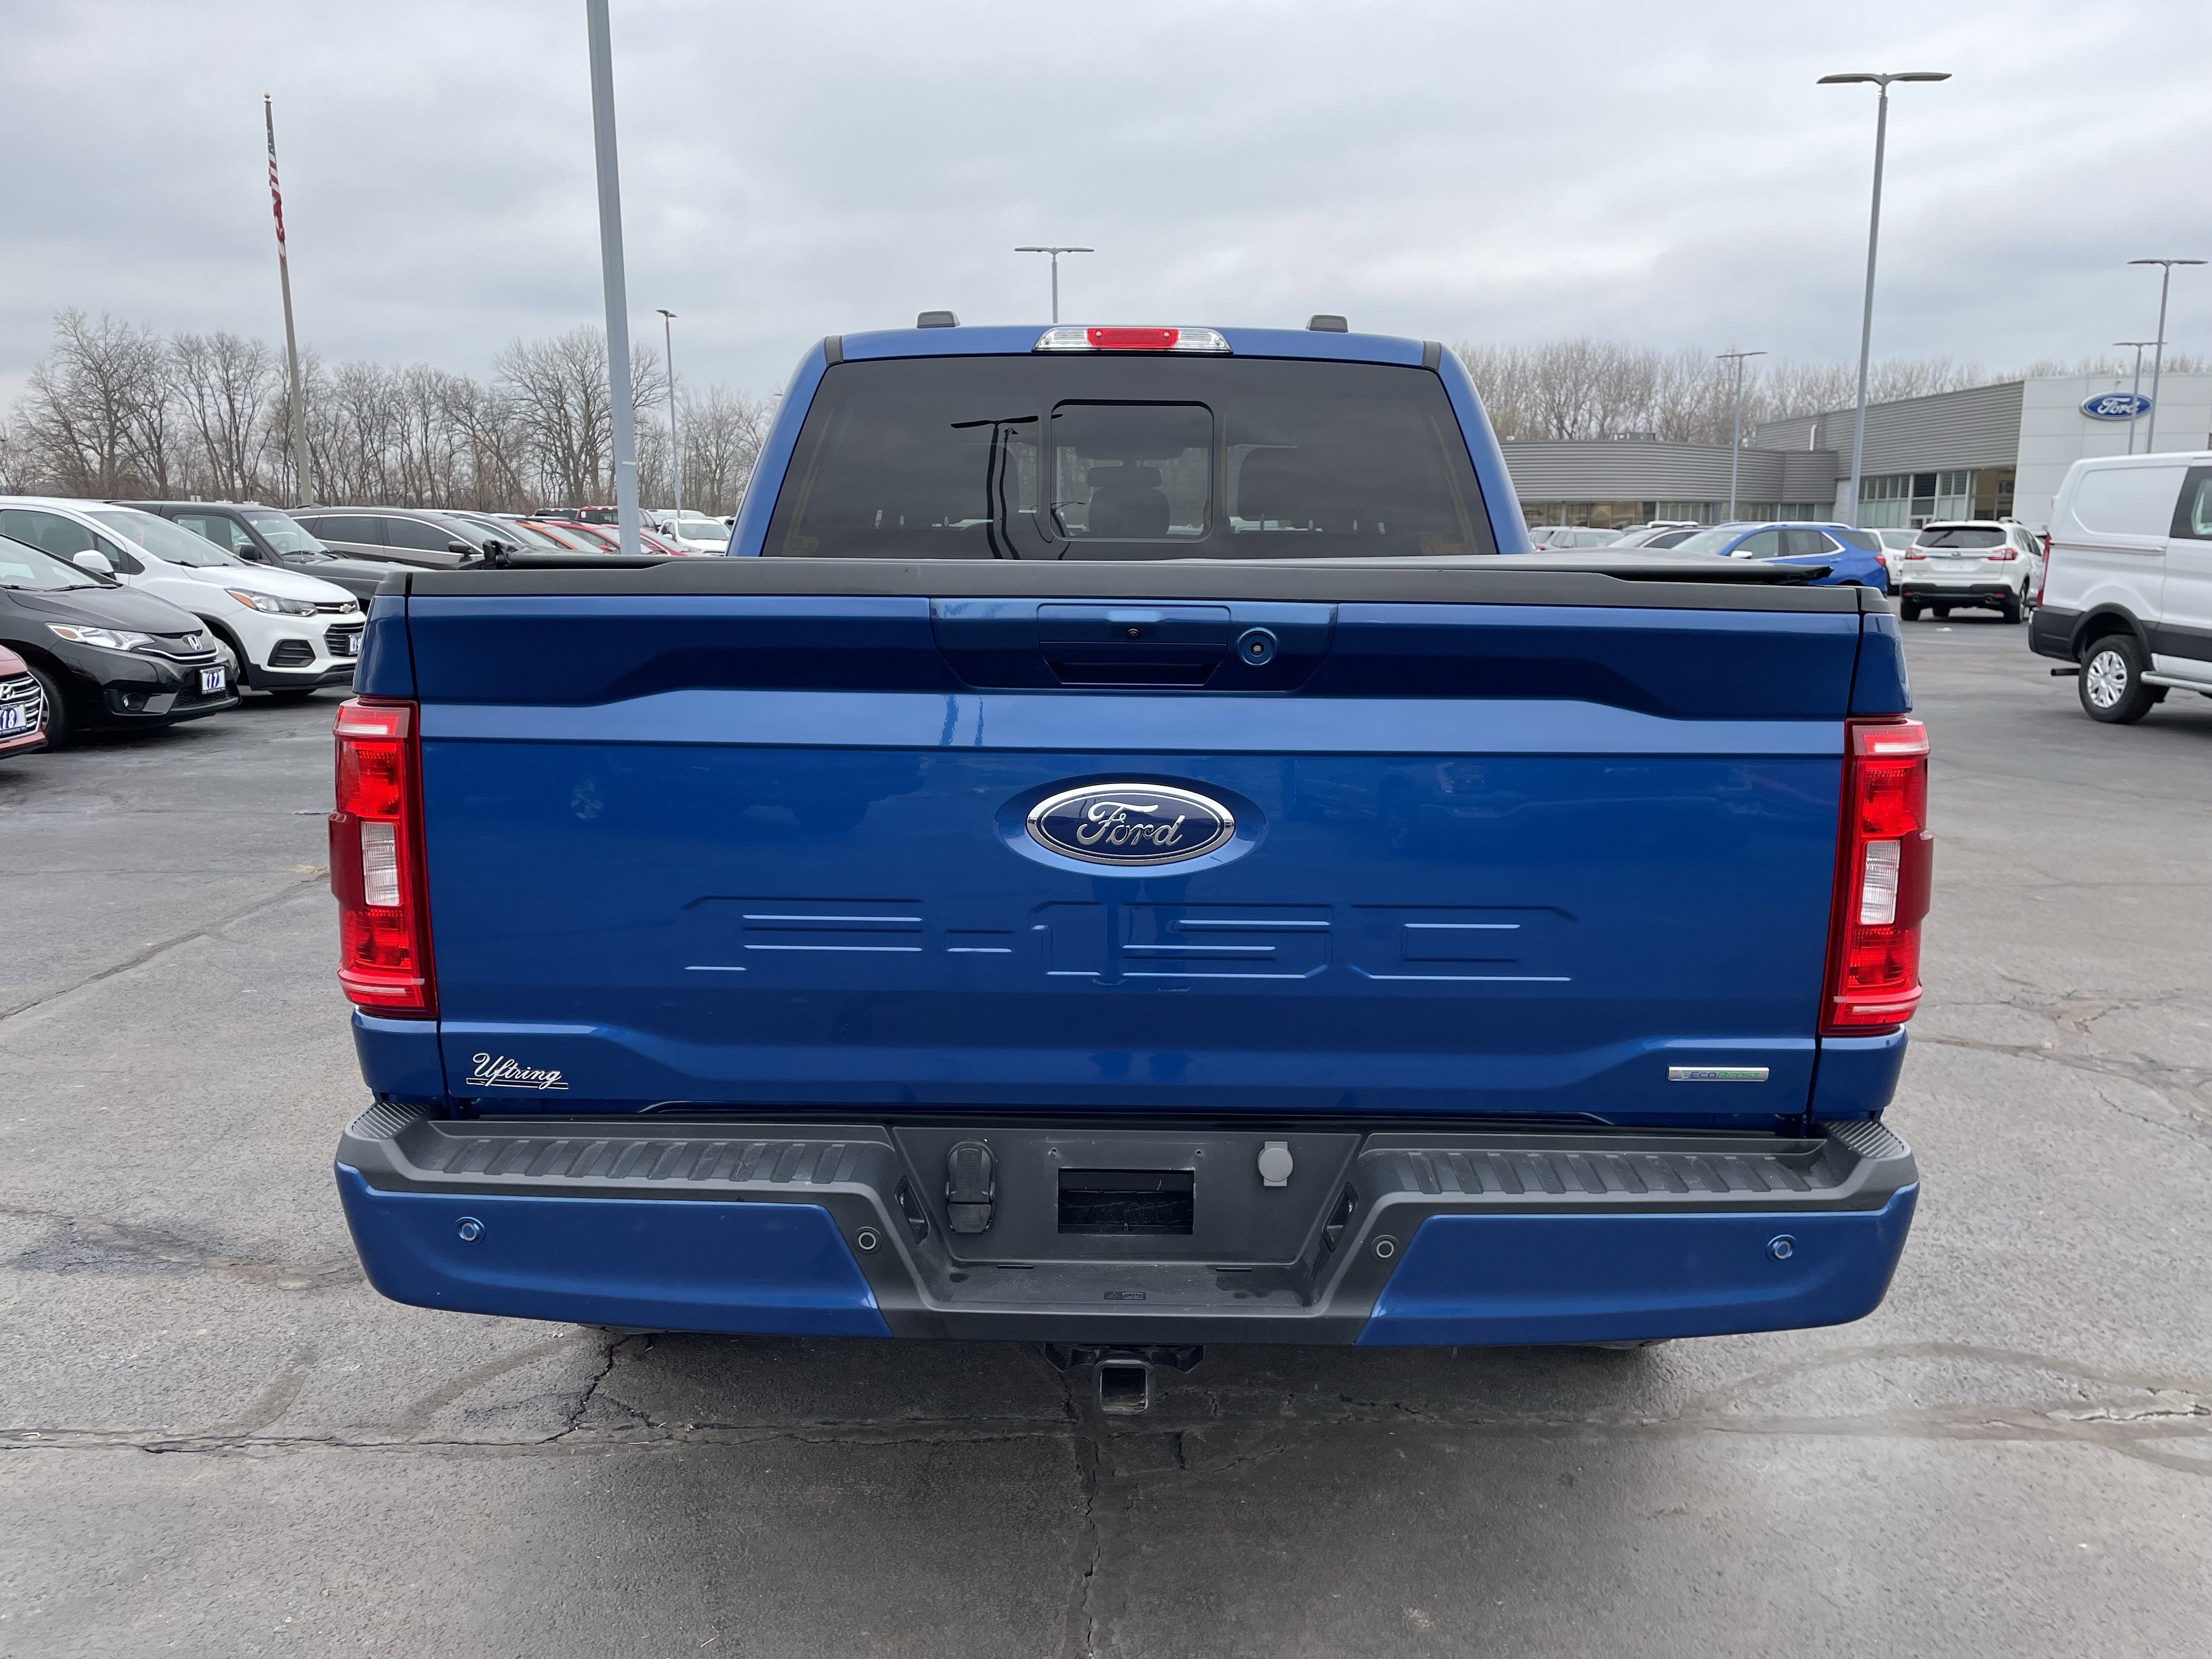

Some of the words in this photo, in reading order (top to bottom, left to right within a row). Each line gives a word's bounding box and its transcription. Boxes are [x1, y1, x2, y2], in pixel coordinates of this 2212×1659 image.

[208, 672, 218, 689] 17
[2, 709, 15, 730] 18
[1076, 801, 1186, 847] Ford
[680, 894, 1577, 983] F-150
[472, 1052, 562, 1090] Uftring
